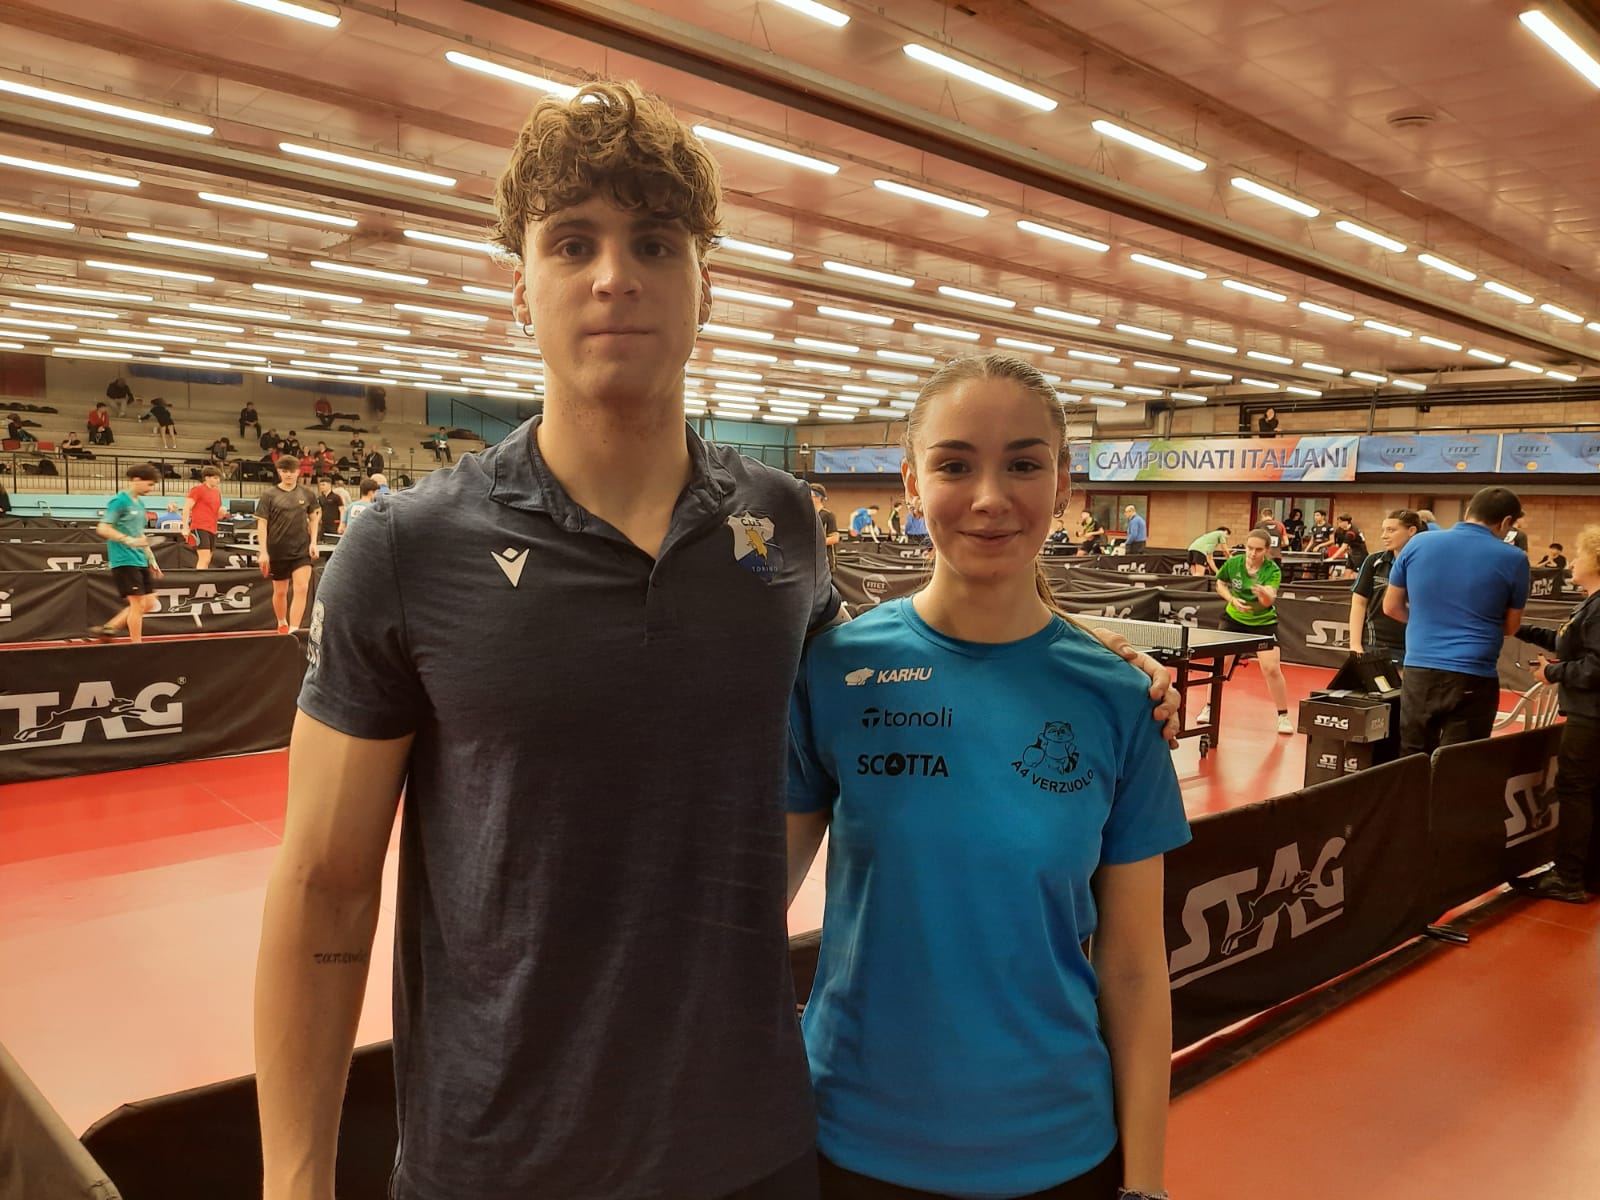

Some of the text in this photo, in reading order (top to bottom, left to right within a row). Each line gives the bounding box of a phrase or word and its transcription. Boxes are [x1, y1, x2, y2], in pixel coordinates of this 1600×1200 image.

[1096, 447, 1348, 470] CAMPIONATI ITALIANI
[876, 667, 933, 684] KARHU
[884, 706, 953, 727] tonoli
[1314, 715, 1349, 730] STAG
[857, 752, 949, 777] SCOTTA
[1011, 761, 1094, 793] A4 VERZUOLO
[1169, 836, 1346, 990] STAG
